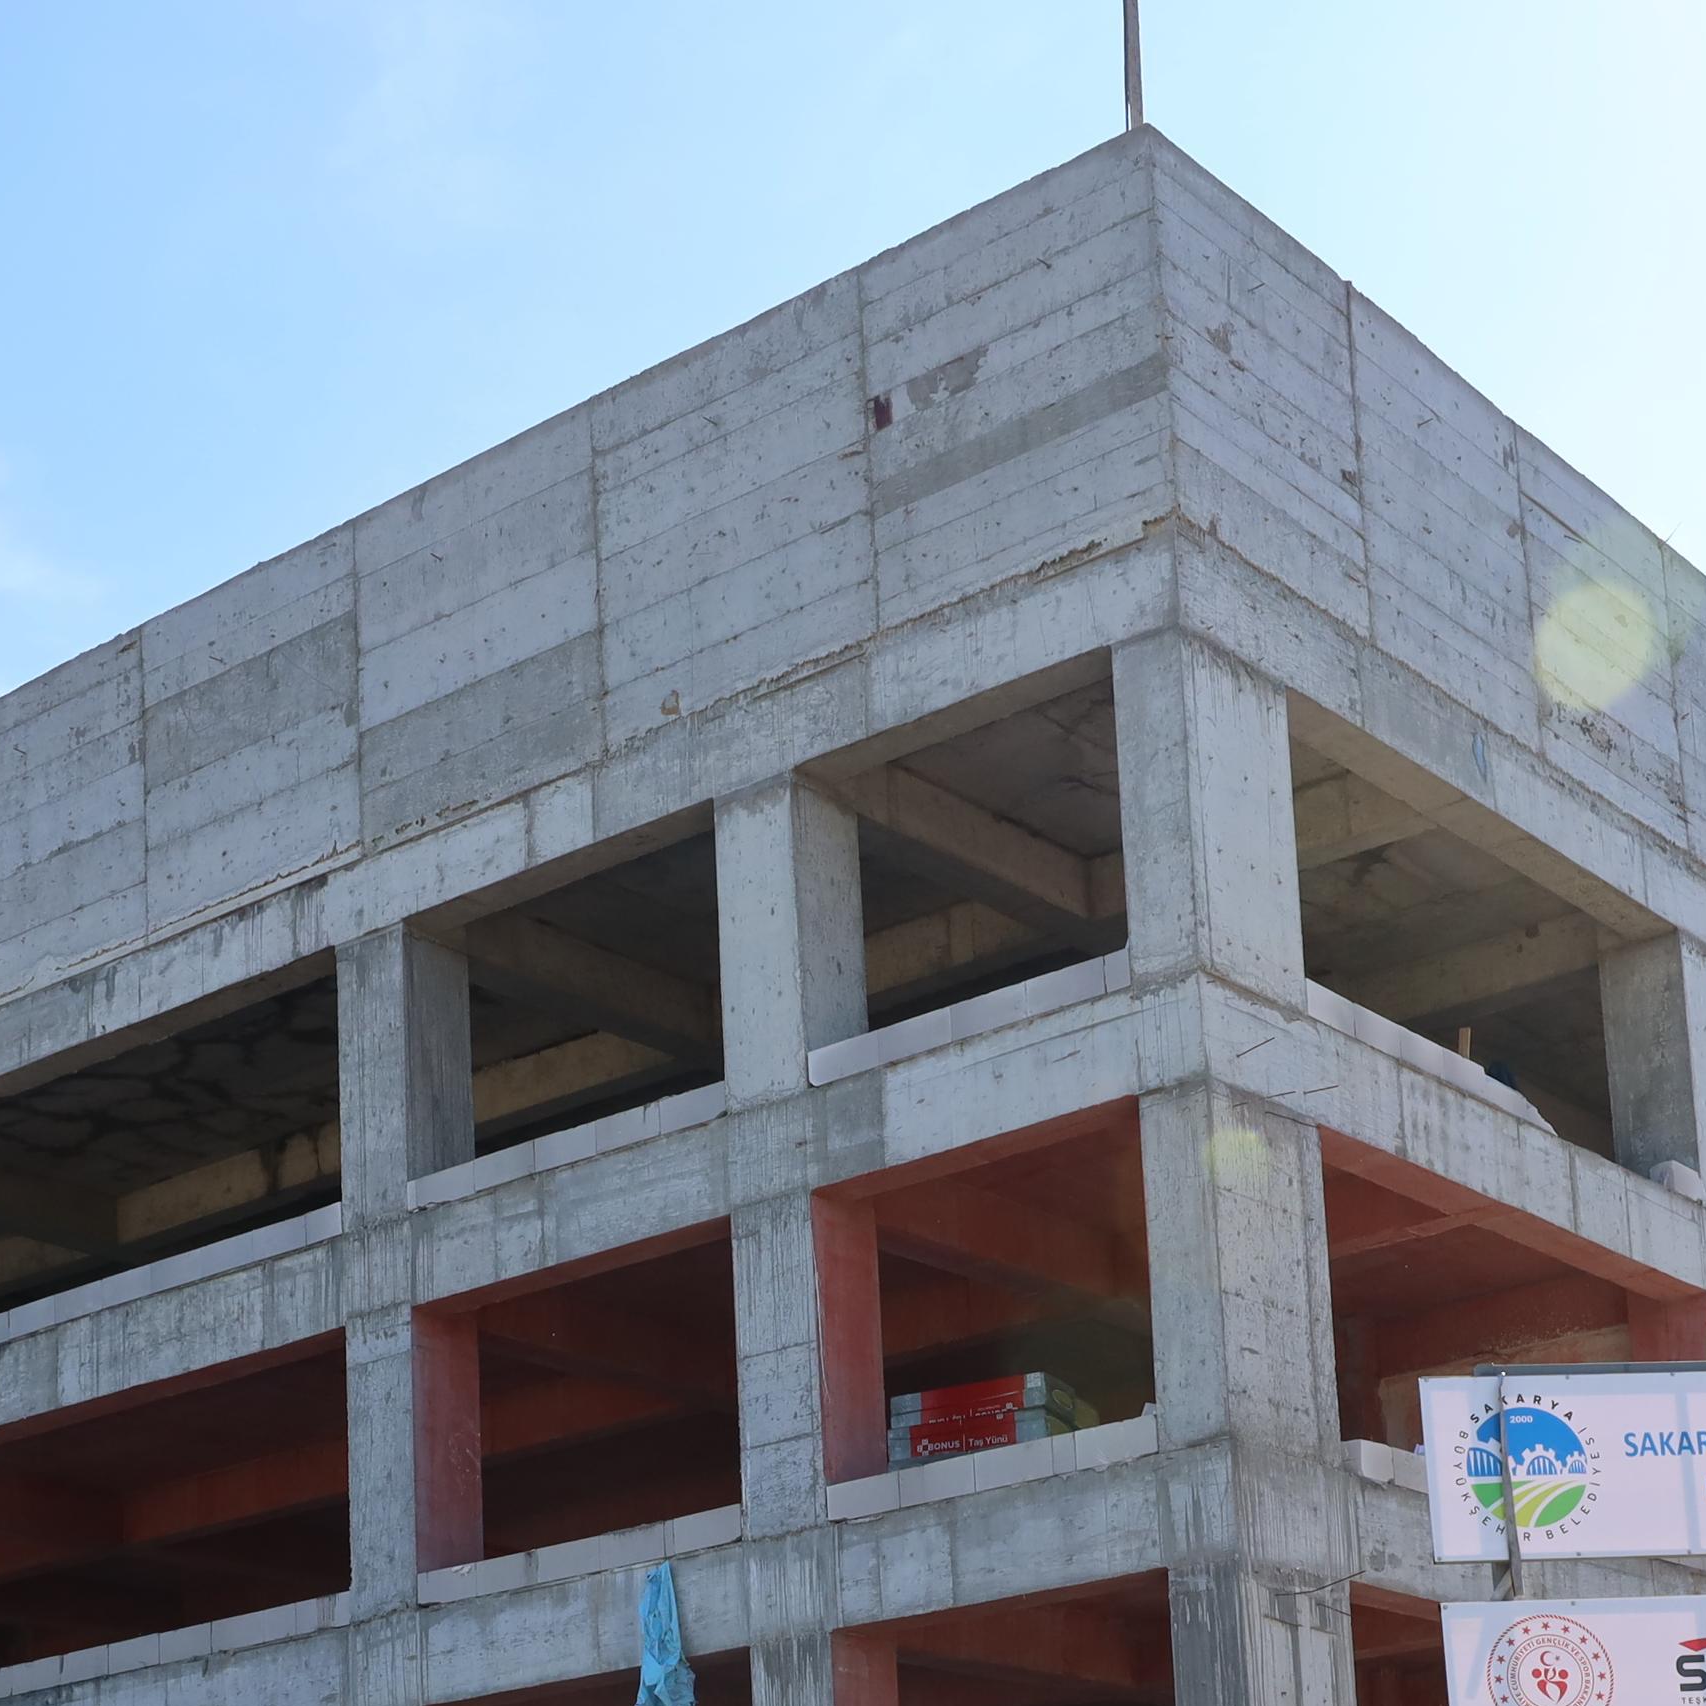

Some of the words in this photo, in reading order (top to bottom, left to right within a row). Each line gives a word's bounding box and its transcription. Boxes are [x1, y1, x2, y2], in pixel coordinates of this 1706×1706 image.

[1509, 1415, 1534, 1424] 2000
[928, 1439, 961, 1451] BONUS
[968, 1437, 984, 1448] Taş
